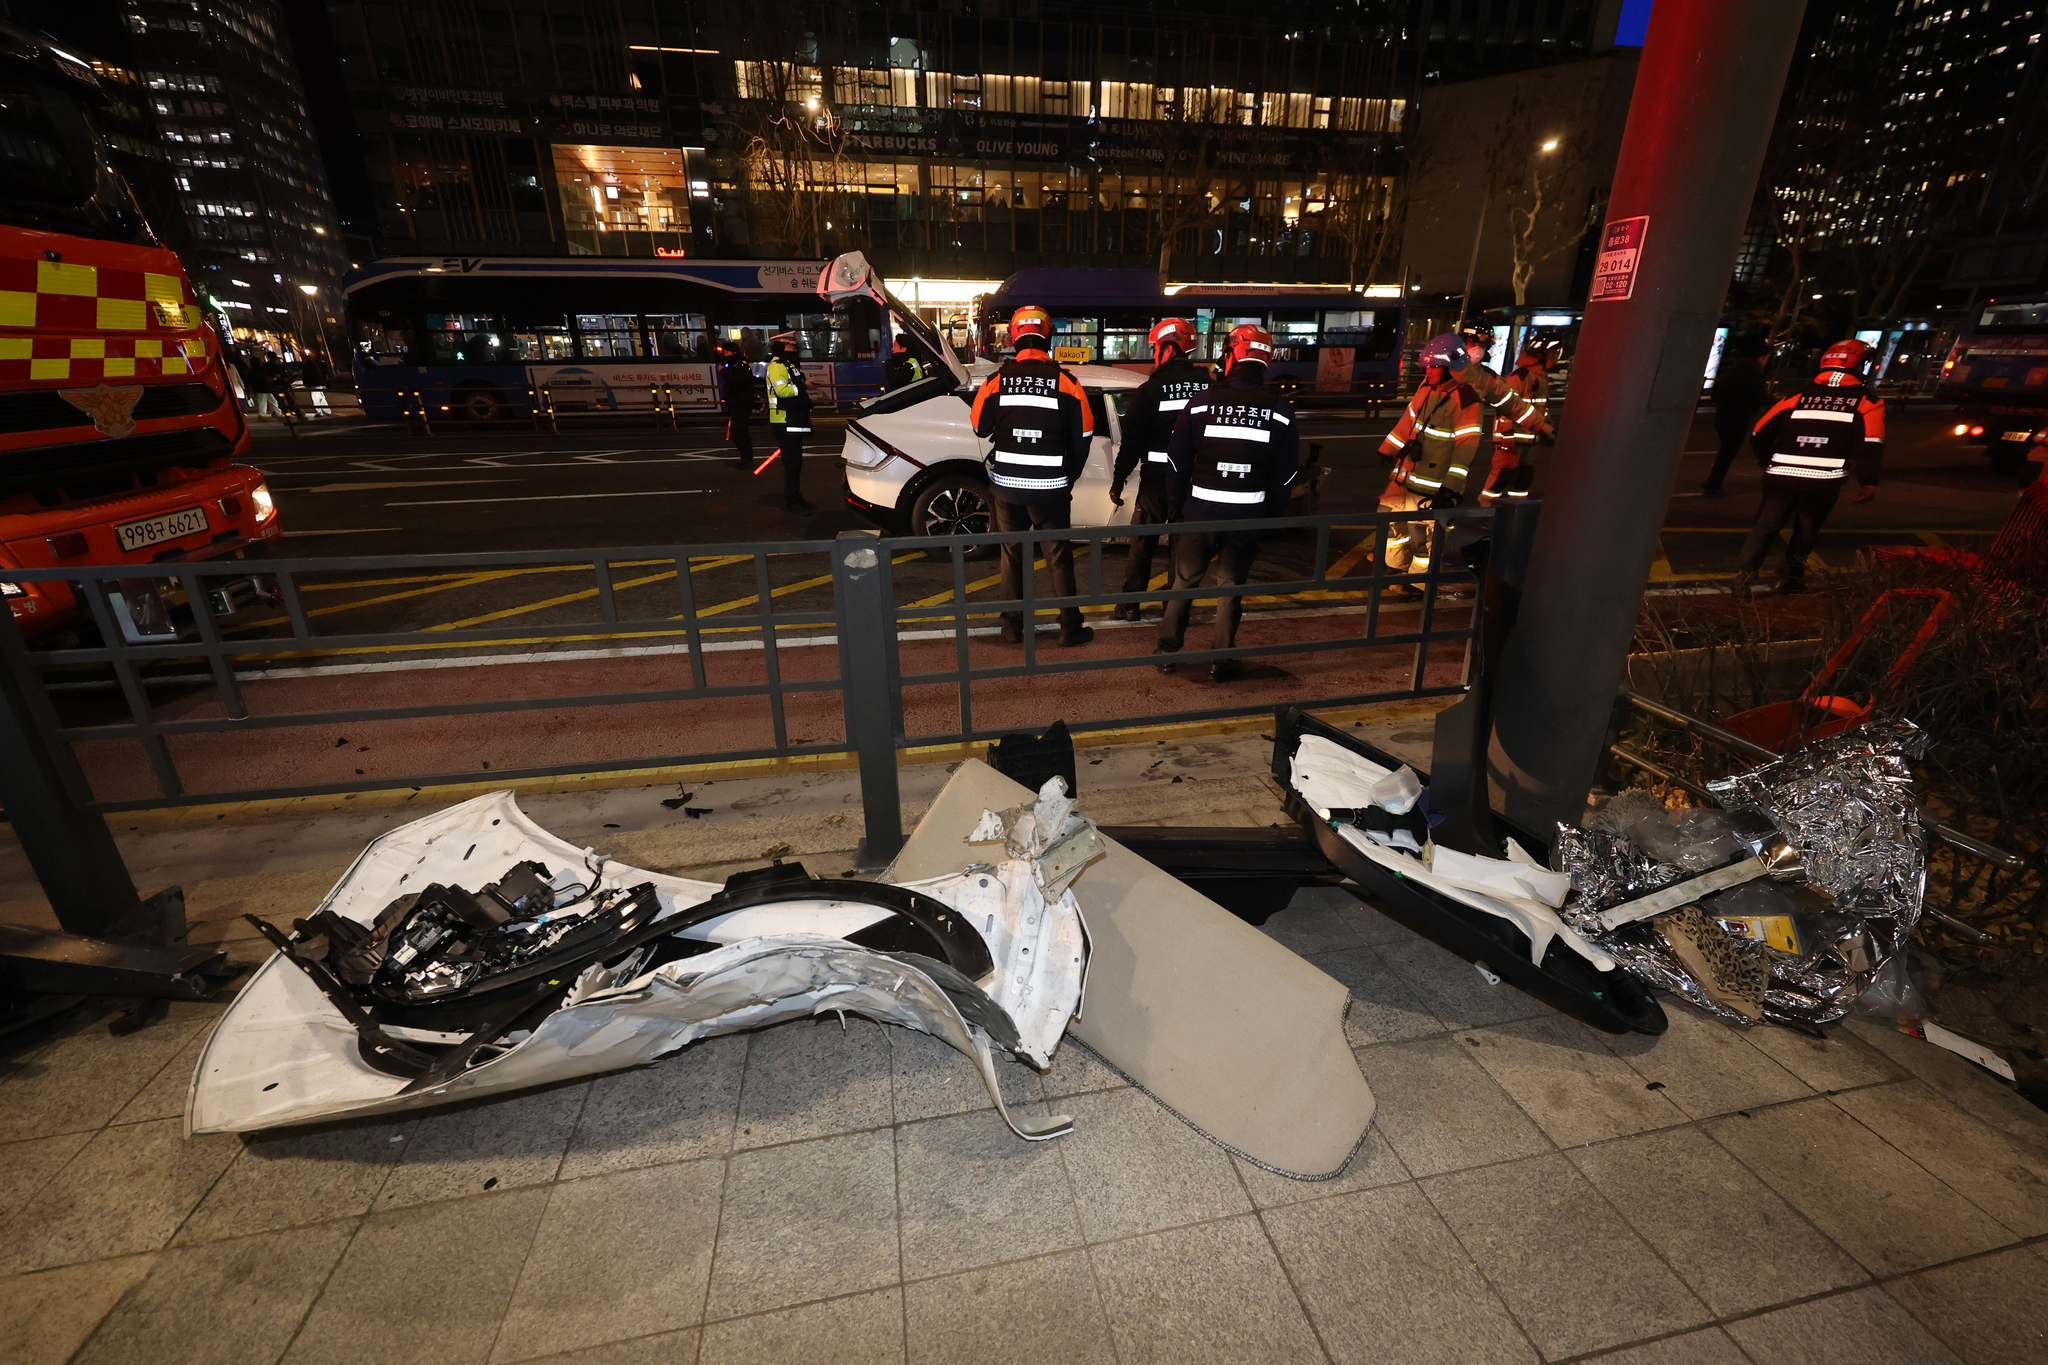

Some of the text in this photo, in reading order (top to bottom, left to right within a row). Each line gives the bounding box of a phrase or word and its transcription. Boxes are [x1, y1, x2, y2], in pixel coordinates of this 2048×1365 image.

[614, 124, 662, 138] 의료재단
[841, 135, 937, 150] STARBUCKS
[976, 140, 1059, 156] OLIVE YOUNG
[1608, 235, 1630, 247] 종로38
[442, 258, 482, 273] EV
[763, 266, 812, 276] 전기버스 타고
[1599, 259, 1631, 273] 29 014
[790, 279, 799, 288] 숨
[681, 373, 702, 381] 마세요
[1002, 376, 1056, 390] 119구조대
[1008, 386, 1048, 396] RESCUE
[1169, 391, 1197, 400] RESC
[1800, 395, 1858, 407] 119구조대
[1803, 403, 1846, 411] RESCUE
[1210, 405, 1271, 421] 119구조대
[1216, 417, 1262, 427] RESCUE
[168, 511, 201, 535] 6621
